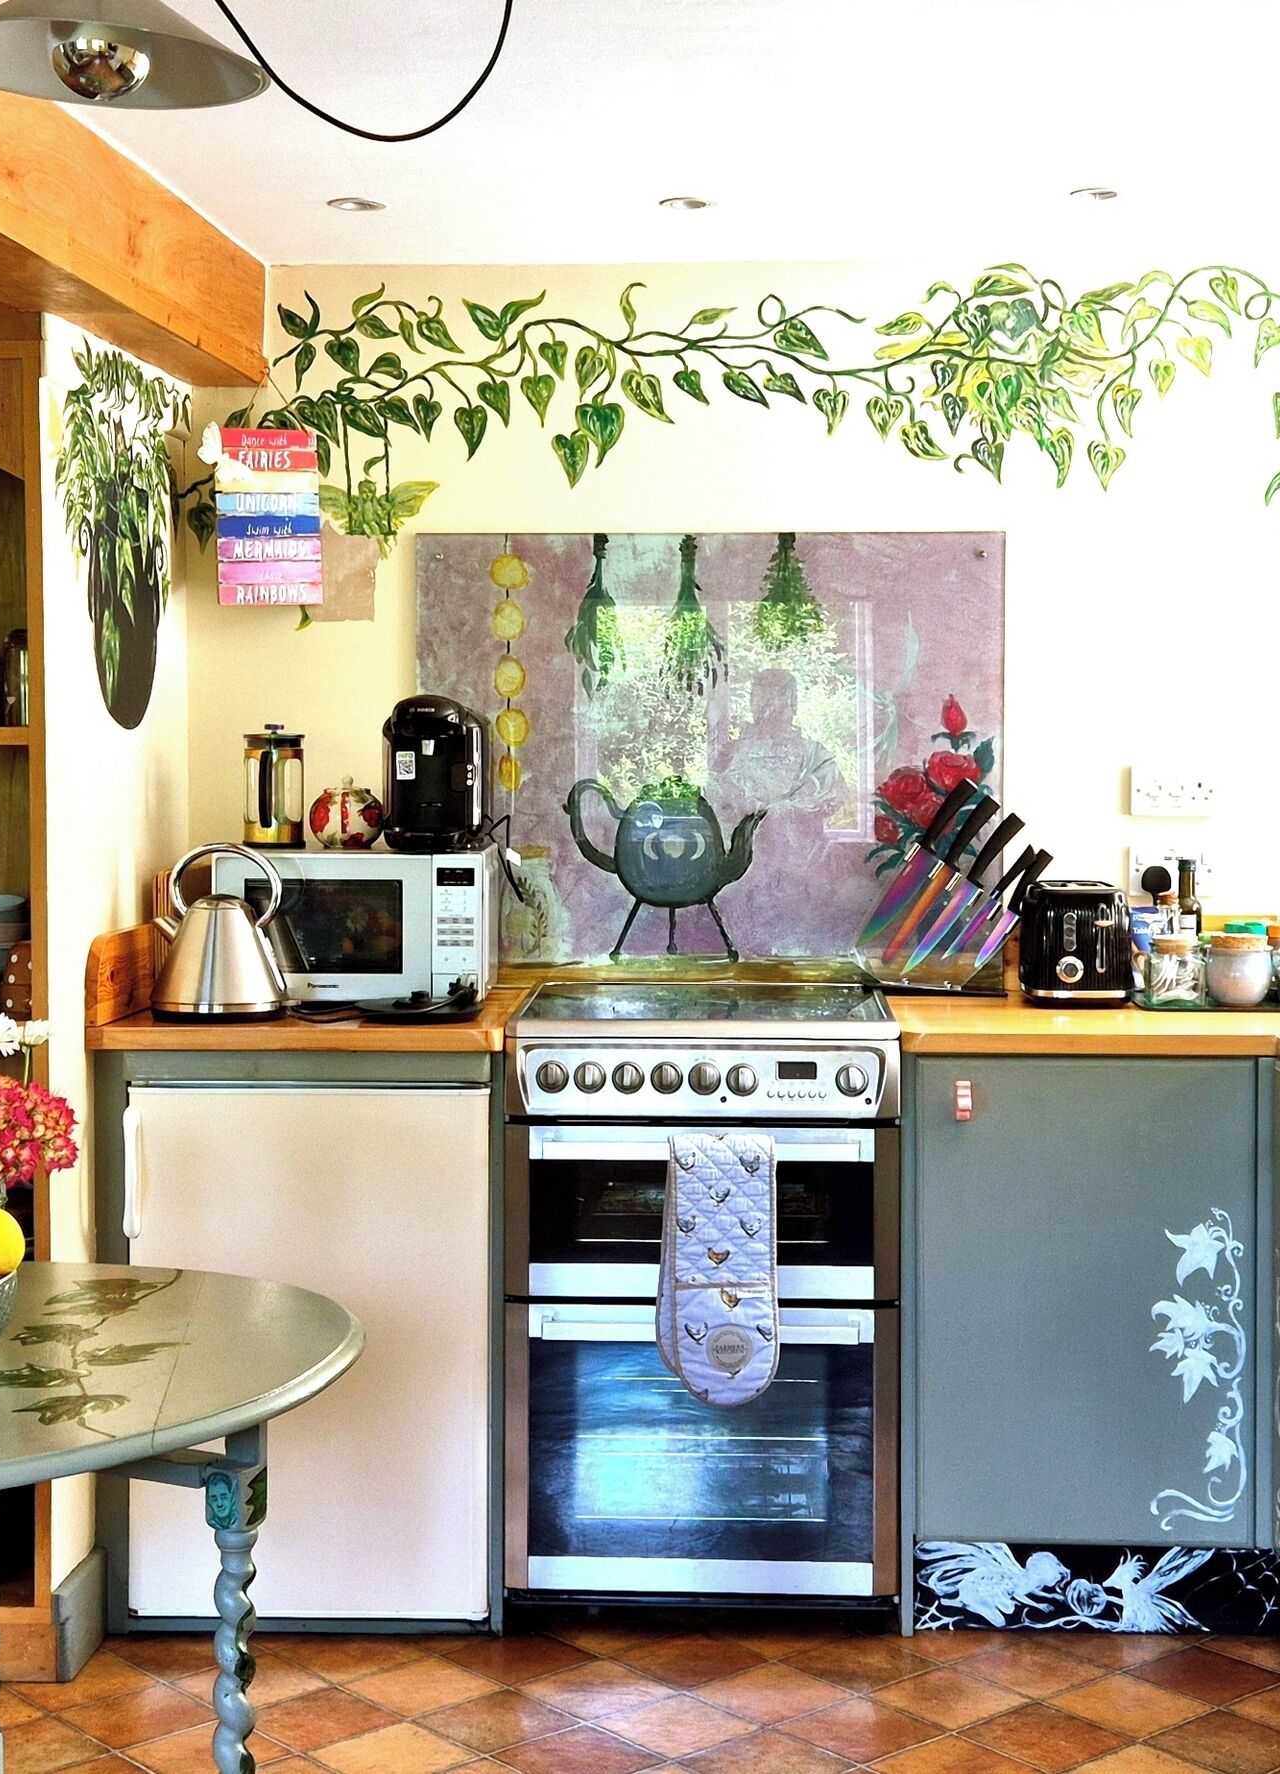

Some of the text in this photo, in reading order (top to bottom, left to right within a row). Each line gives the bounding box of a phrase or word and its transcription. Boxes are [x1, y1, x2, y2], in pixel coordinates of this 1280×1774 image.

[269, 433, 288, 446] with
[238, 450, 291, 472] FAIRIES
[236, 493, 298, 515] UNICORN
[273, 521, 293, 535] with
[233, 539, 307, 561] MERMAIDS
[236, 584, 308, 604] RAINBOWS
